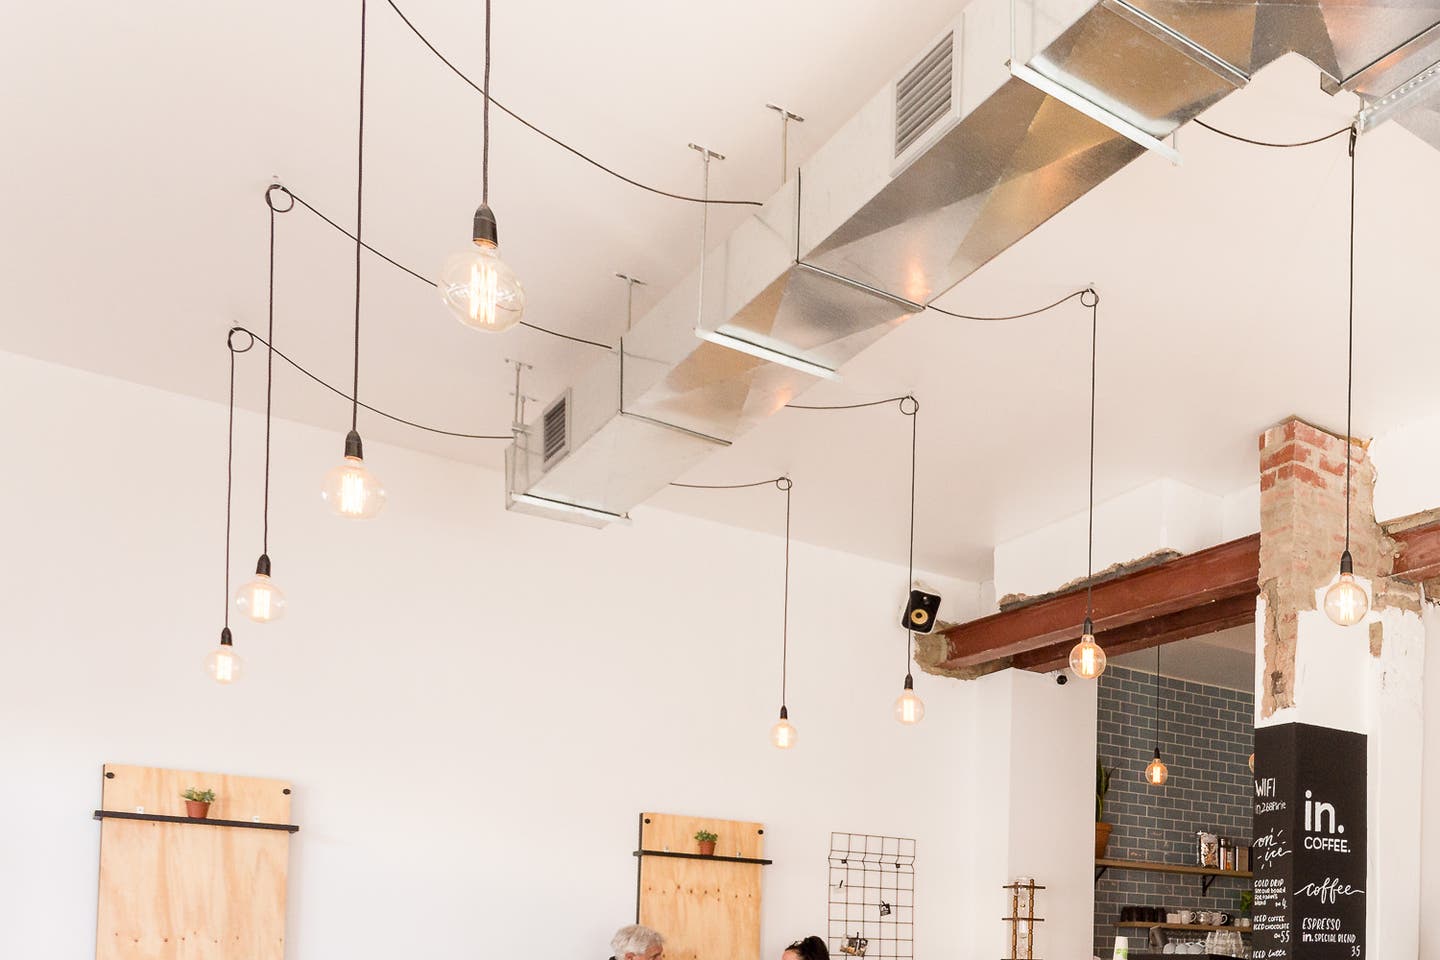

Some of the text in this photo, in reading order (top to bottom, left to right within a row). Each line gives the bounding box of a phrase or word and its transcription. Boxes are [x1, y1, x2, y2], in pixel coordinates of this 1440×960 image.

[1255, 778, 1275, 797] WIFI
[1304, 789, 1345, 834] in.
[1304, 836, 1351, 853] COFFEE.
[1294, 877, 1365, 904] coffee
[1302, 917, 1341, 931] ESPRESSO
[1314, 933, 1337, 943] SPECIAL
[1338, 934, 1356, 944] BLEND
